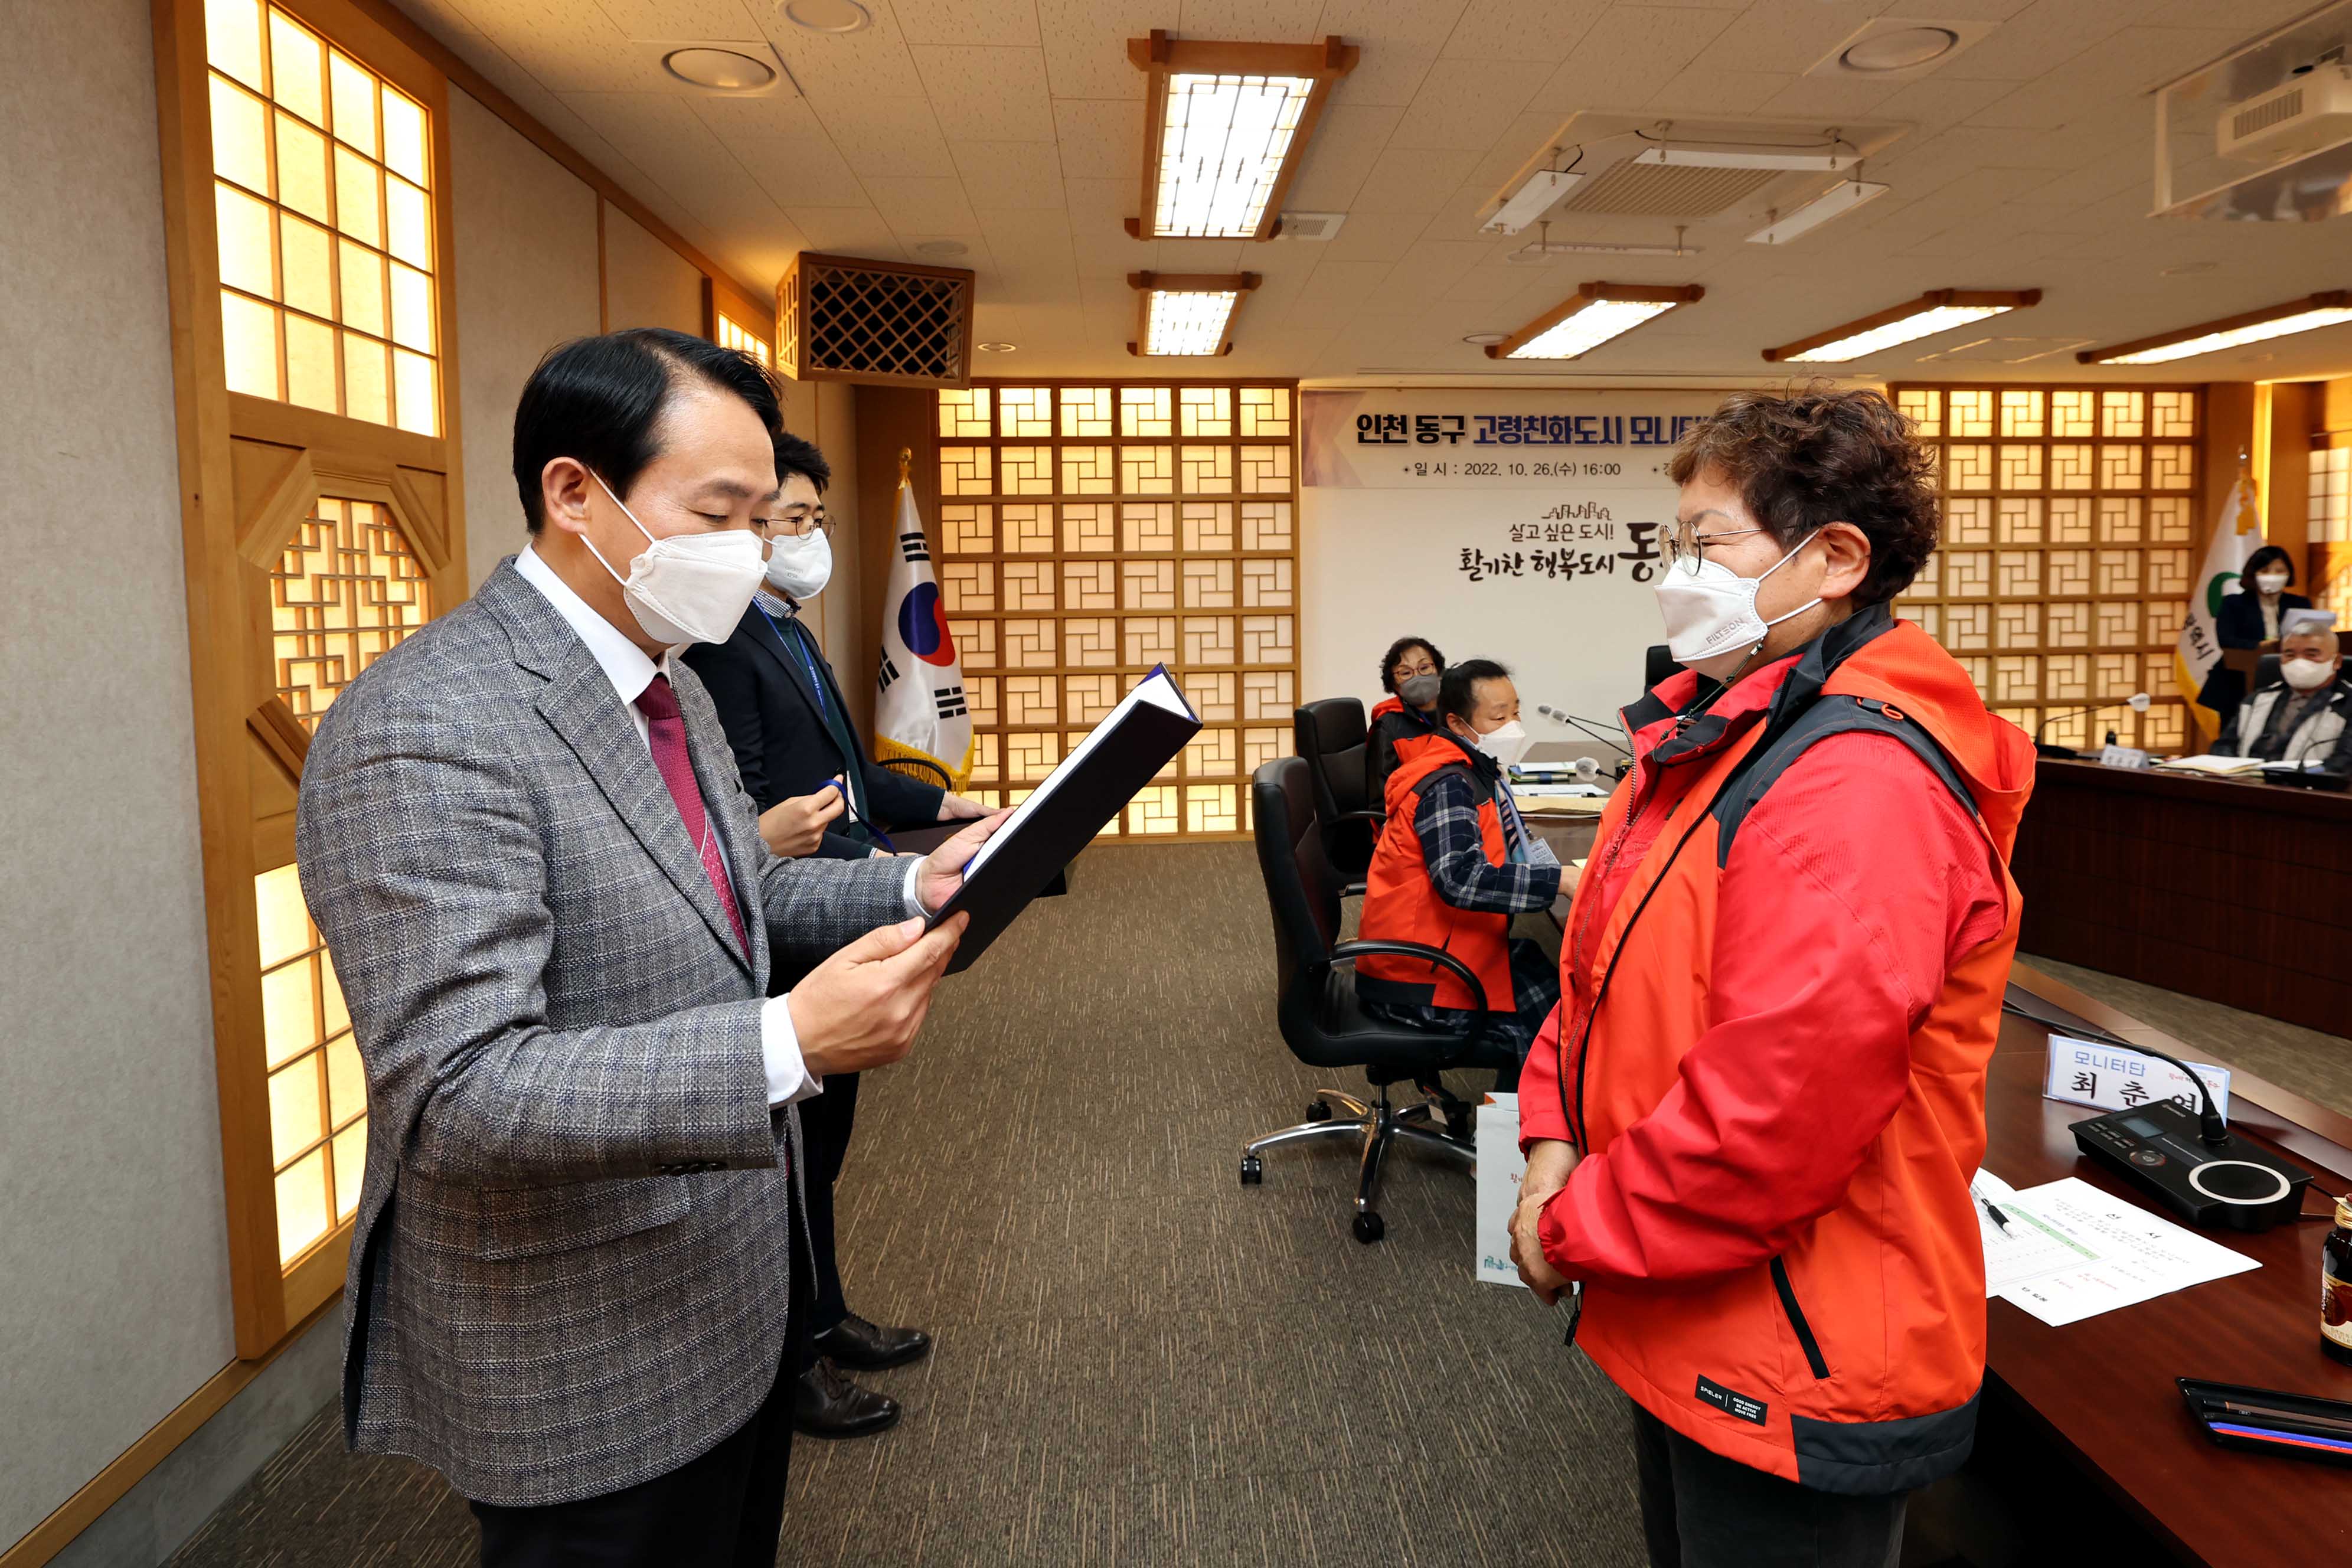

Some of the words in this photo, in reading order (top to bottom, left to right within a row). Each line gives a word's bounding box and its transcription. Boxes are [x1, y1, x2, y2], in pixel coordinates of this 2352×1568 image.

[1356, 414, 1407, 444] 인천
[1415, 415, 1465, 444] 동구
[1473, 415, 1623, 445] 고령친화도시
[1630, 416, 1710, 445] 모니
[1464, 463, 1502, 476] 2022.
[1508, 463, 1528, 476] 10.
[1533, 462, 1577, 476] 26.(수)
[1582, 463, 1621, 476] 16:00
[1508, 523, 1541, 542] 살고
[1544, 523, 1575, 542] 싶은
[1578, 524, 1615, 541] 도시!
[1459, 548, 1524, 582] 활기찬
[1530, 548, 1615, 581] 행복도시
[1617, 522, 1664, 583] 동
[2075, 1051, 2146, 1077] 모니터단
[2070, 1072, 2097, 1099] 최
[1700, 1386, 1722, 1400] SPIELER
[1742, 1406, 1756, 1415] ACTIVE
